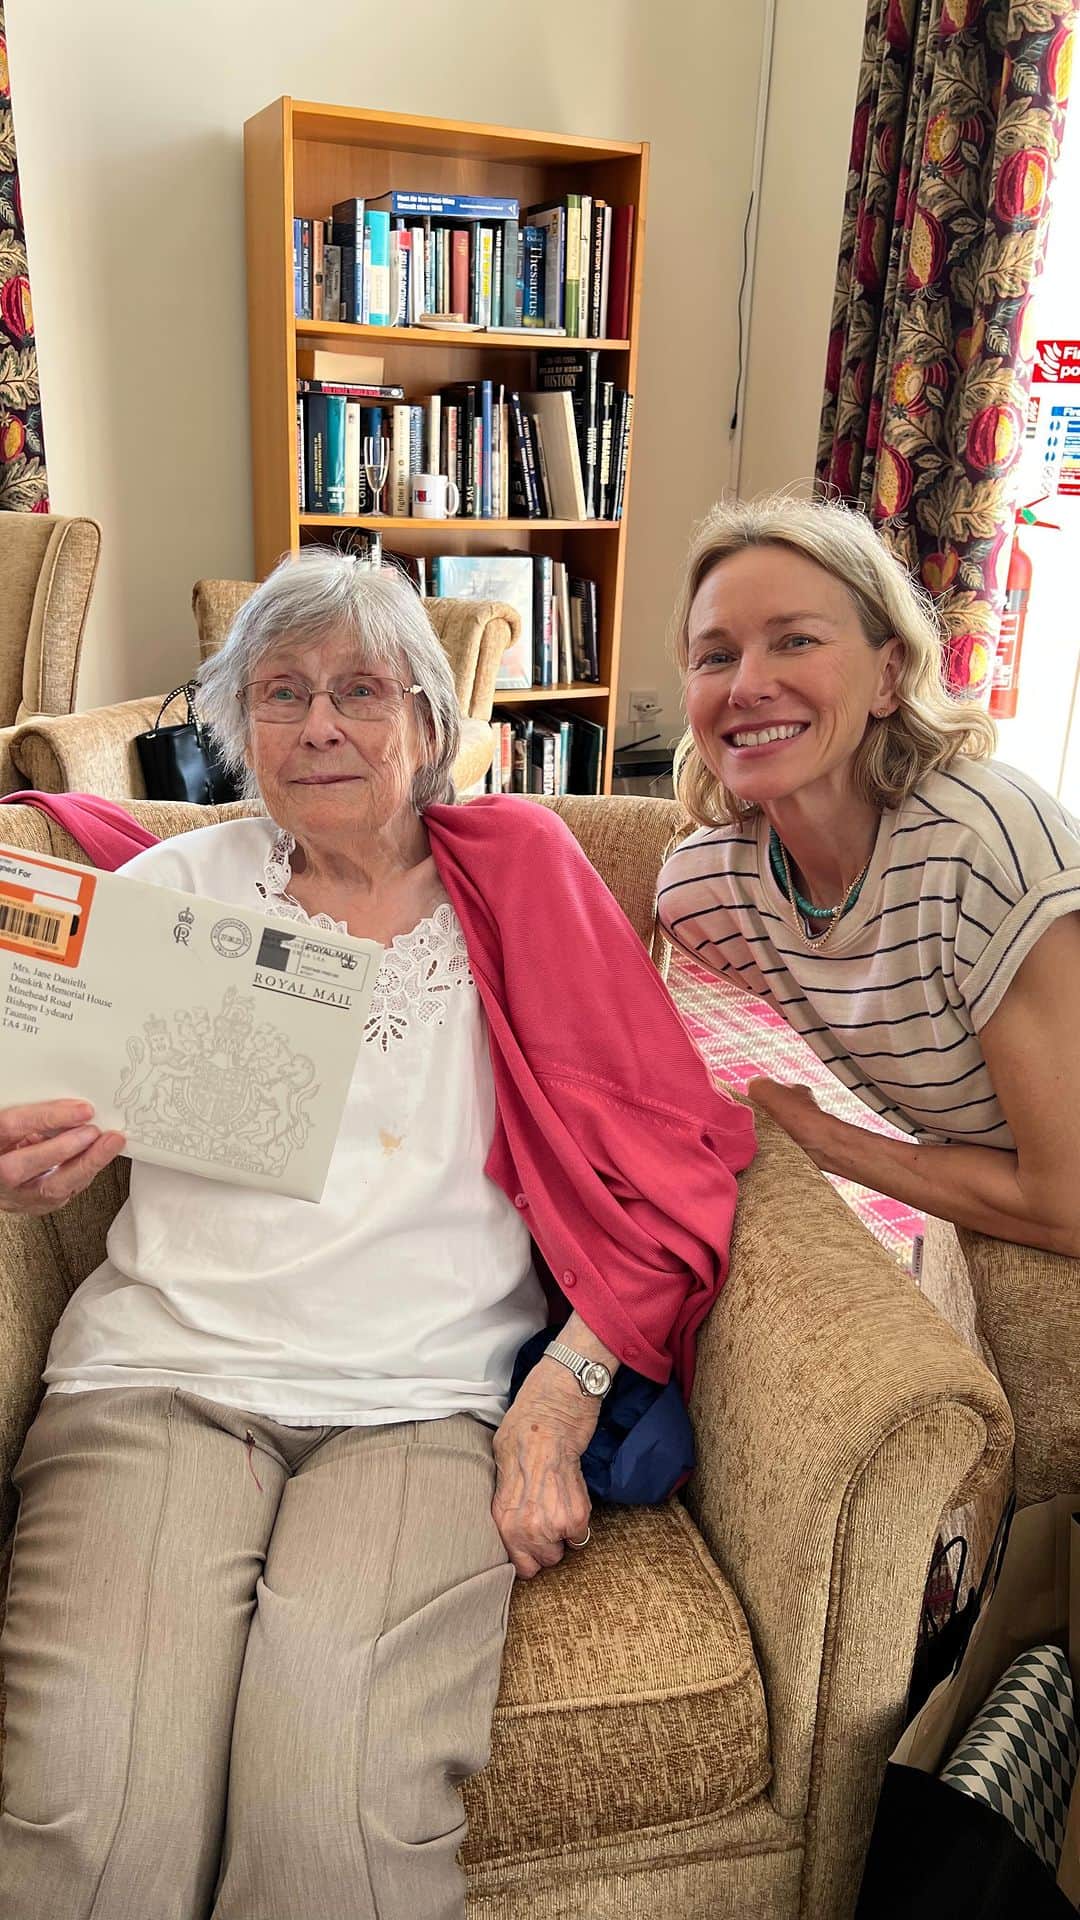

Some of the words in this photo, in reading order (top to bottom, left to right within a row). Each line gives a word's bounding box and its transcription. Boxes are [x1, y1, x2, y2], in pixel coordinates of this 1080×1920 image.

[595, 216, 603, 237] WAR
[594, 239, 602, 271] WORLD
[529, 245, 544, 316] Thesaurus
[593, 272, 601, 308] SECOND
[544, 374, 577, 387] HISTORY
[602, 418, 611, 439] THE
[600, 439, 611, 485] MARINES
[397, 469, 405, 487] Boys
[397, 487, 405, 512] Fighter
[466, 486, 474, 501] SAS
[17, 868, 32, 878] For
[12, 961, 30, 974] Mrs.
[33, 967, 52, 980] Jane
[8, 984, 49, 1002] Minehead
[50, 996, 72, 1009] Road
[10, 972, 44, 989] Dunkirk
[46, 982, 85, 1001] Memorial
[86, 993, 113, 1008] House
[253, 971, 307, 995] ROYAL
[313, 987, 353, 1006] MAIL
